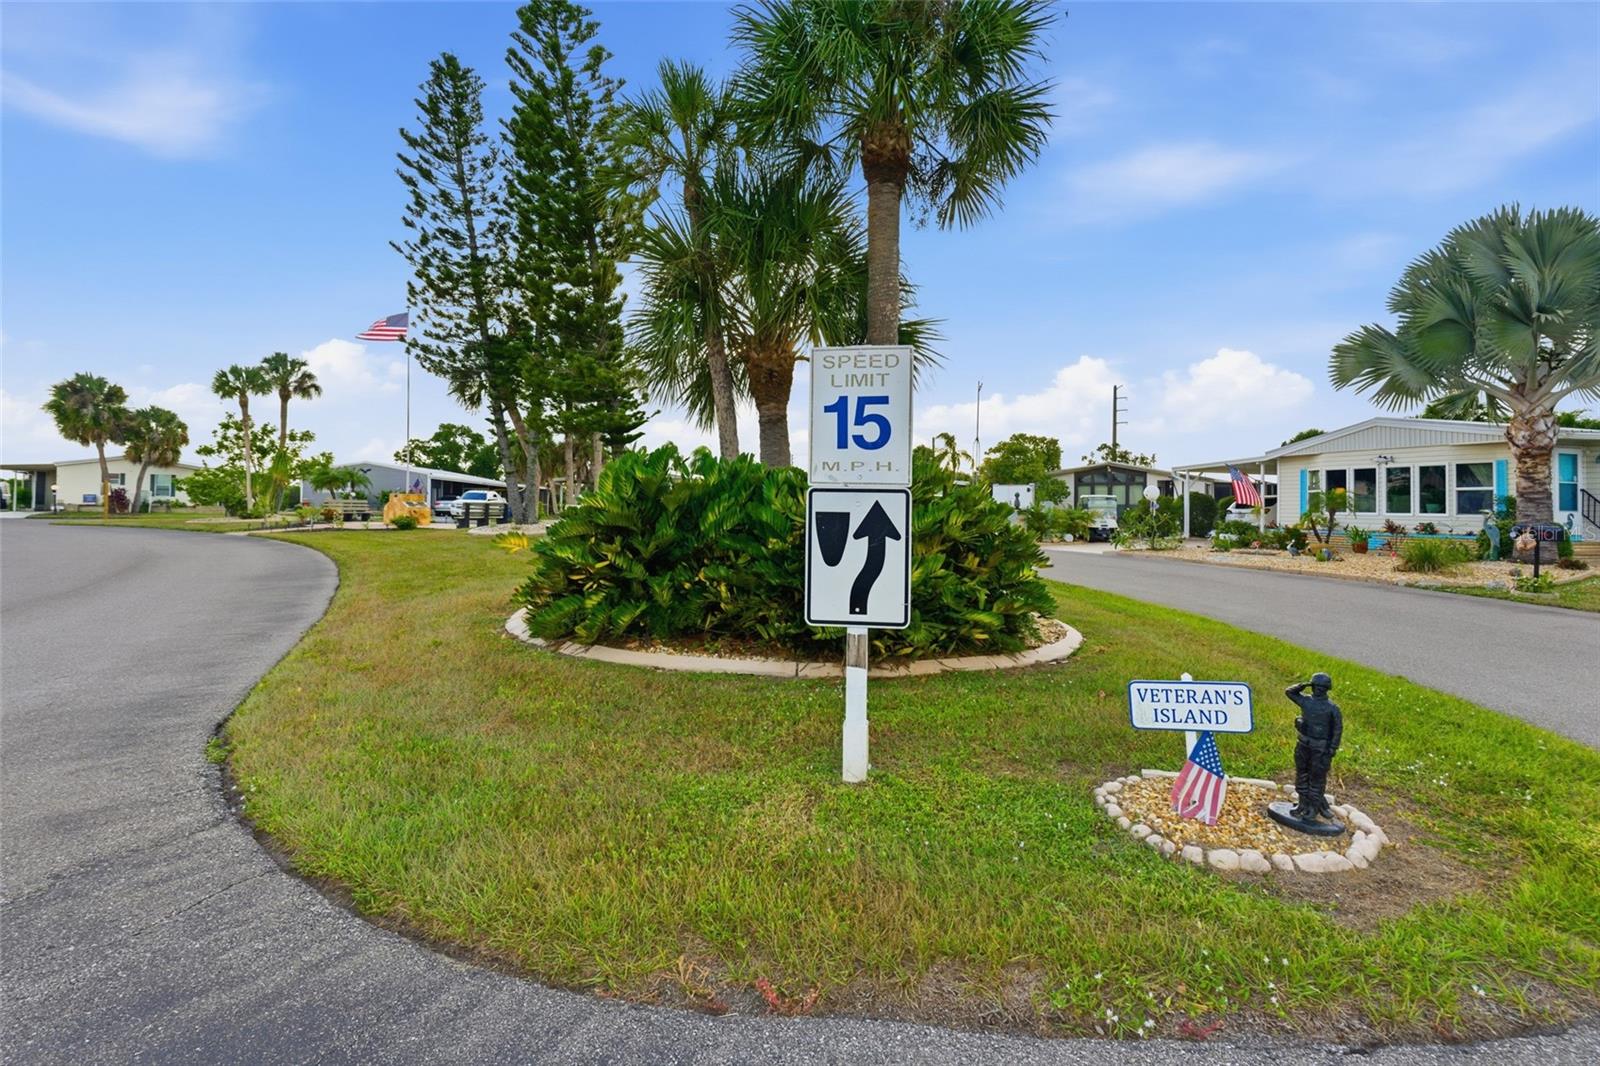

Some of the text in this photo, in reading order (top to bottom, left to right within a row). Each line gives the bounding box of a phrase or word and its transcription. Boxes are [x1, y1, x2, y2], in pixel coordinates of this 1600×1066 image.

[823, 353, 900, 369] SPEED
[831, 372, 890, 388] LIMIT
[824, 395, 892, 450] 15
[822, 461, 900, 473] M.P.H.
[1137, 688, 1243, 706] VETERAN'S
[1153, 708, 1228, 725] ISLAND
